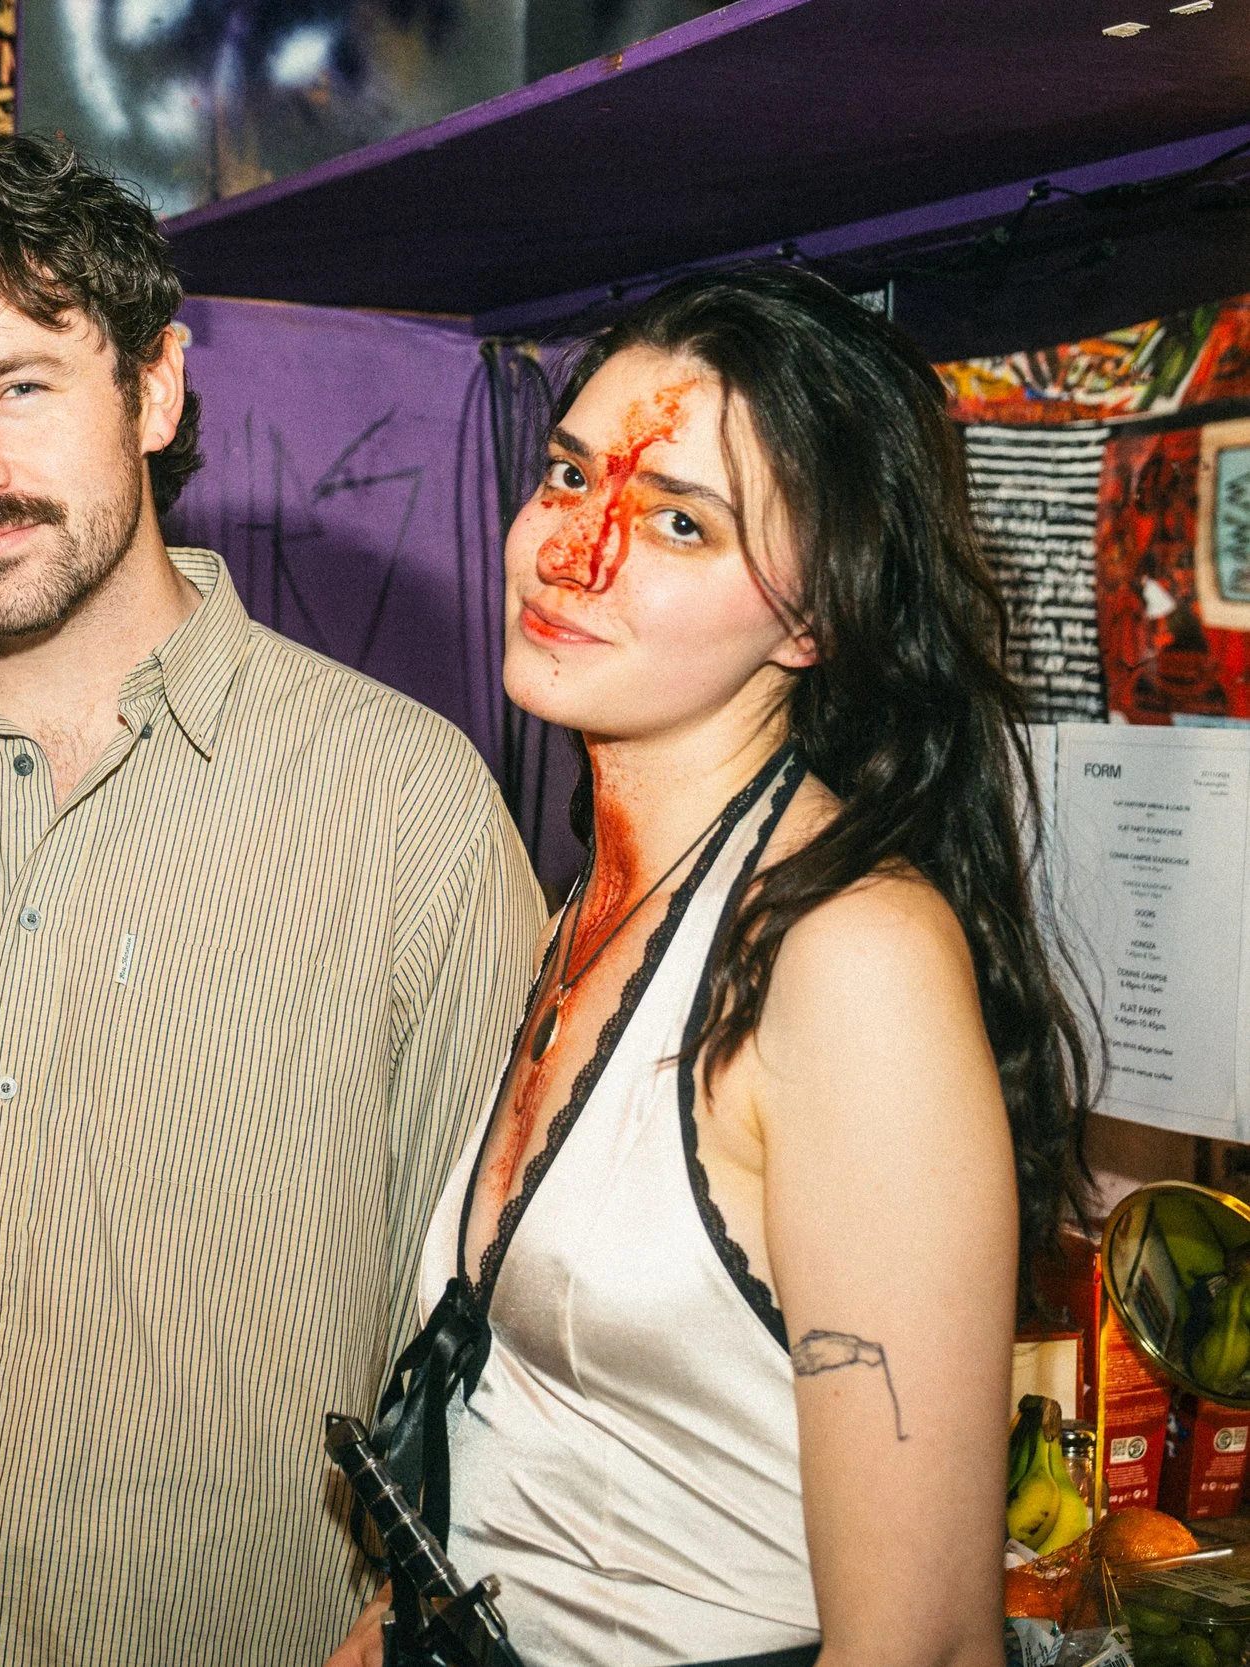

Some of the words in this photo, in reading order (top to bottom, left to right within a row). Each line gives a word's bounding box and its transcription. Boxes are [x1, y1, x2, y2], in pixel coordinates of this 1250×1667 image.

[1084, 762, 1122, 779] FORM
[1120, 1002, 1137, 1013] FLAT
[1138, 1004, 1162, 1016] PARTY
